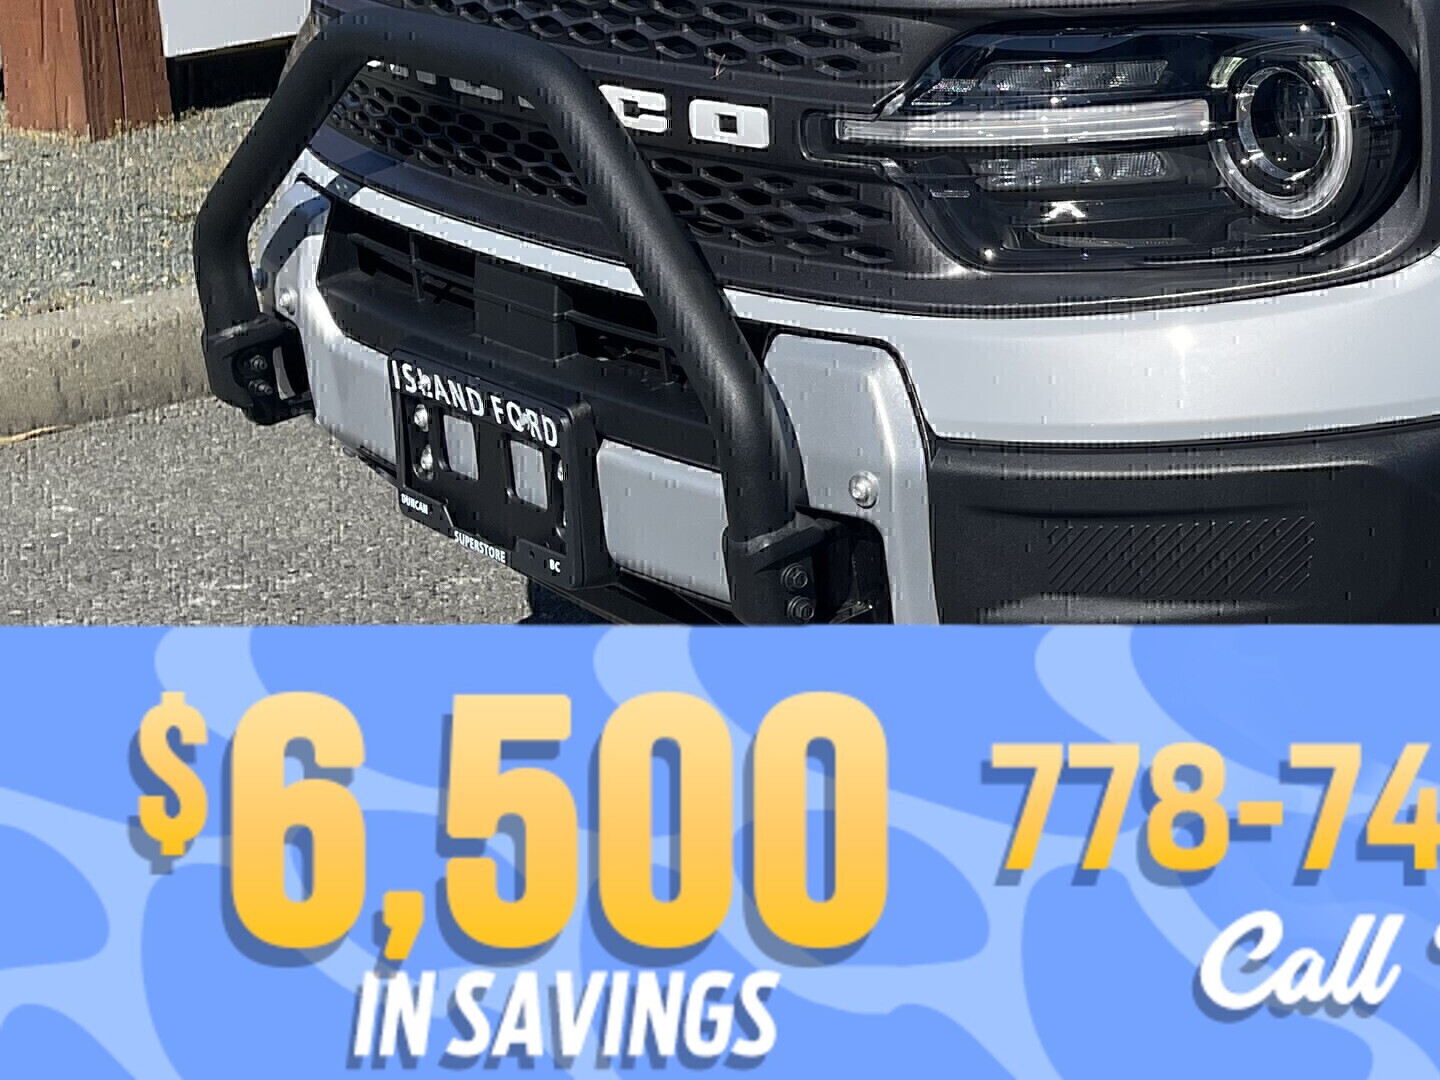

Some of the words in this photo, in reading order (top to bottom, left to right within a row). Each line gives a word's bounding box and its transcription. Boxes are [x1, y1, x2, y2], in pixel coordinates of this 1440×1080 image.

[391, 360, 485, 417] ISLAND
[490, 394, 558, 448] FORD
[454, 530, 506, 564] SUPERSTORE
[549, 558, 561, 573] BC
